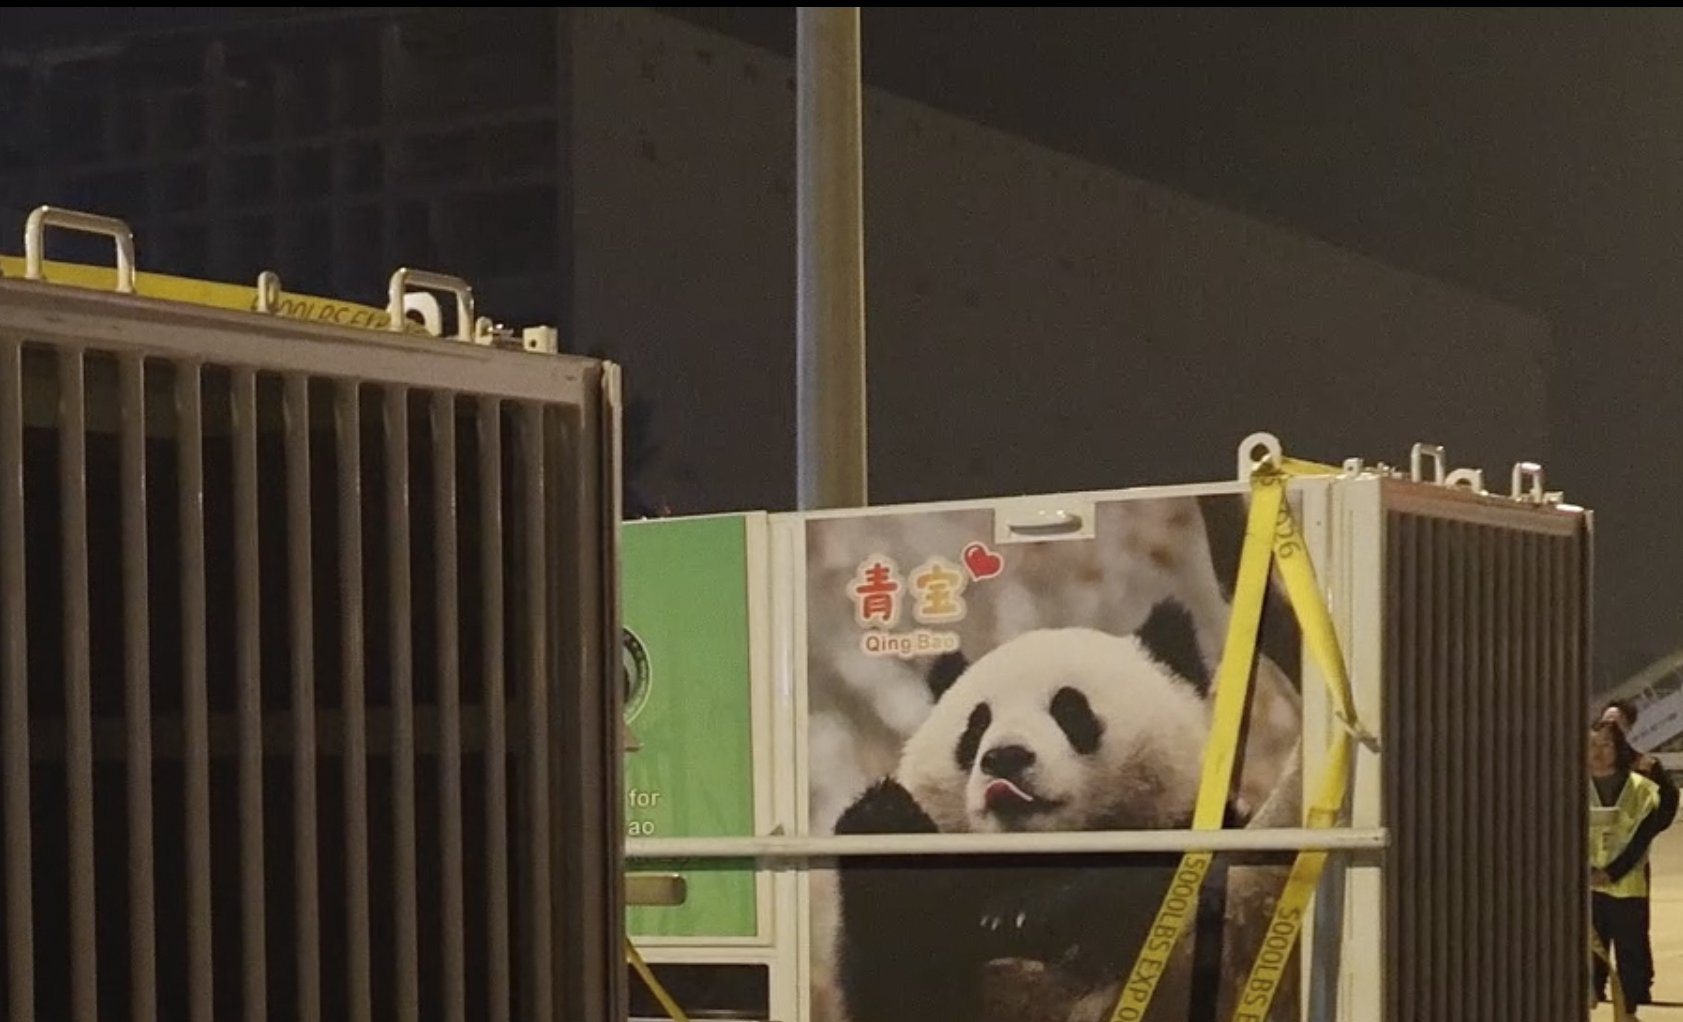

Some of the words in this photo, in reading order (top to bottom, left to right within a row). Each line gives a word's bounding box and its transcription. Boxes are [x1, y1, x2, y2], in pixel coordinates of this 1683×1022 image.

[855, 562, 962, 621] 青宝
[866, 635, 912, 655] Qing
[917, 632, 956, 651] Bao
[627, 788, 661, 807] for
[627, 818, 656, 836] ao
[1148, 856, 1206, 961] 5000LBS
[1128, 956, 1163, 1004] EXP
[1239, 905, 1301, 1008] 5000LBS
